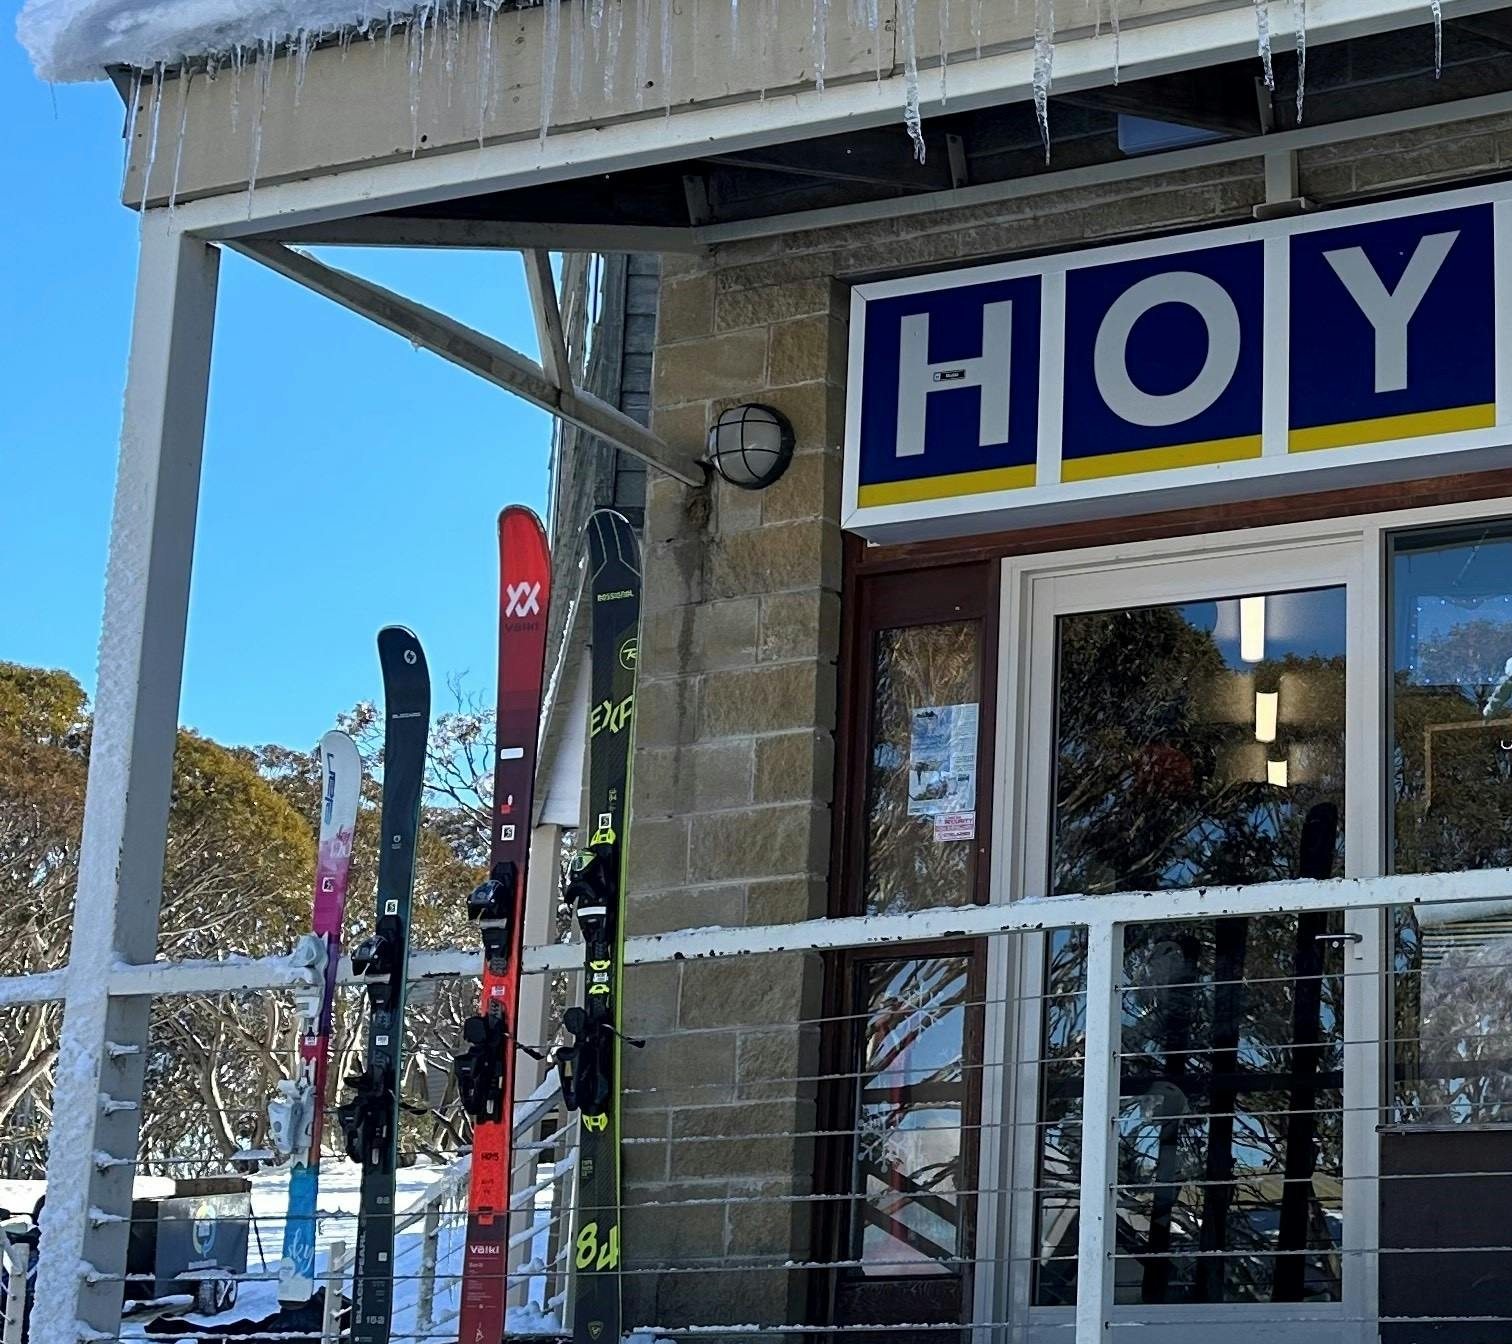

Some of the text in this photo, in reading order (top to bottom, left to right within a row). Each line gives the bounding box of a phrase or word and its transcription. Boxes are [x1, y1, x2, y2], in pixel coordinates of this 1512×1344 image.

[358, 1230, 367, 1275] PEARL
[575, 1222, 619, 1271] 84
[355, 1279, 364, 1324] BLACK
